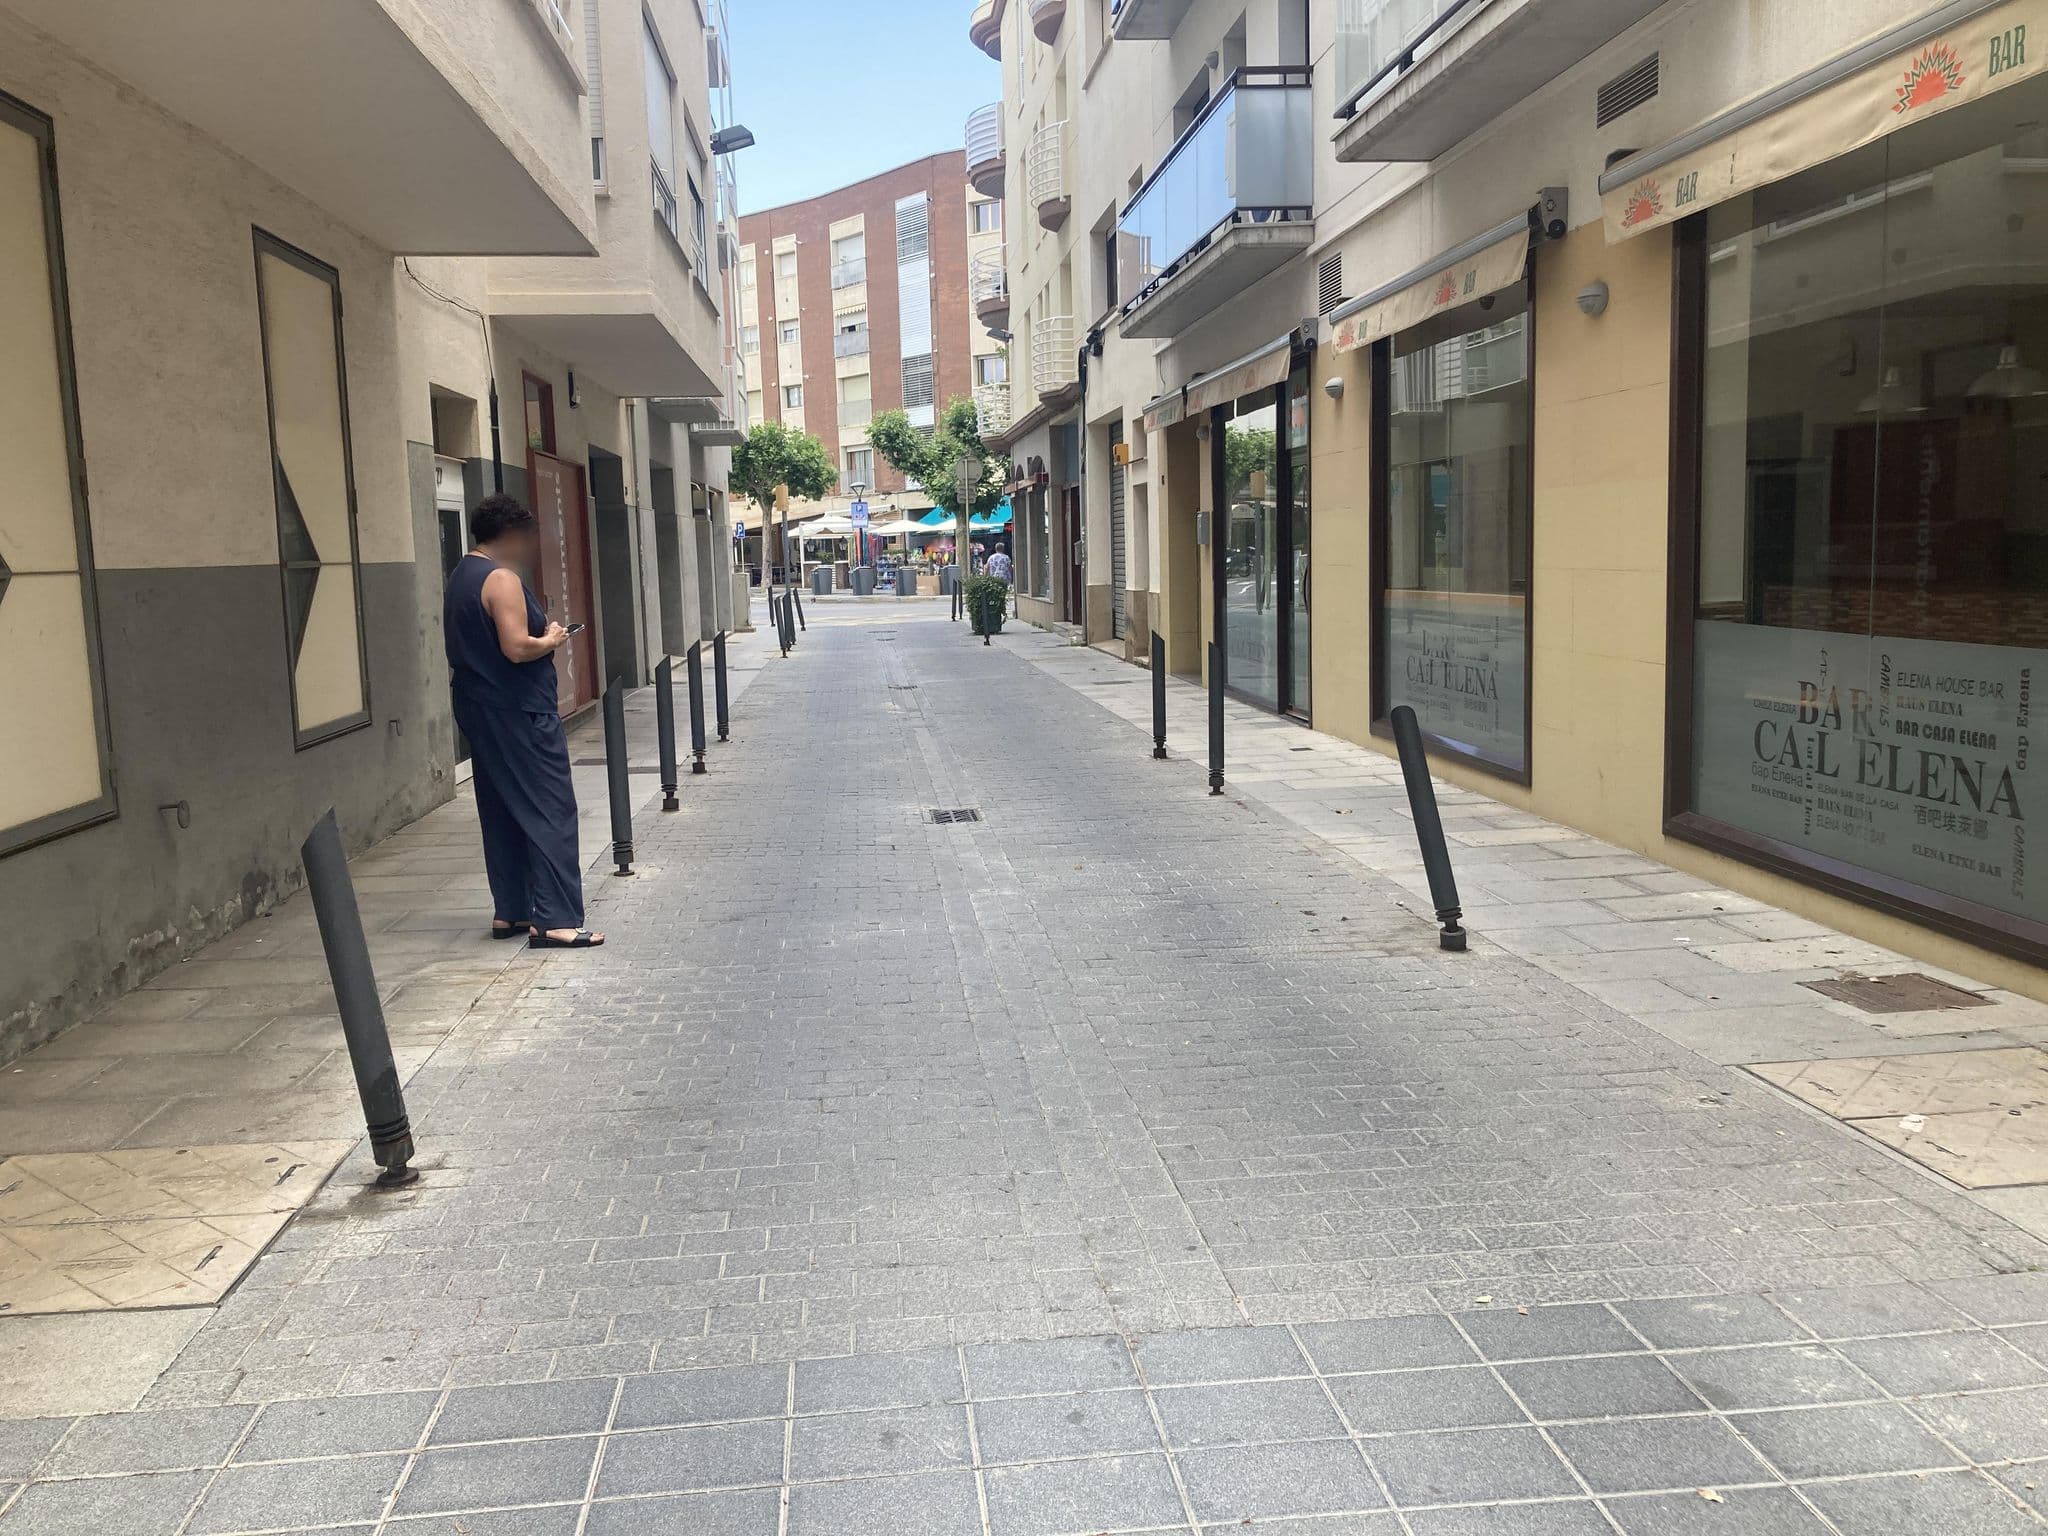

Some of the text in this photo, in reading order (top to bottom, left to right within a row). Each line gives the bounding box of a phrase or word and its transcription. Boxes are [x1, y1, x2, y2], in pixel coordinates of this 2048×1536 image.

[1989, 24, 2026, 78] BAR
[1675, 171, 1699, 208] BAR
[737, 523, 744, 536] P
[1897, 672, 2005, 699] ELENA HOUSE BAR
[1797, 680, 1876, 738] BAR
[1896, 719, 1998, 751] BAR CASA ELENA
